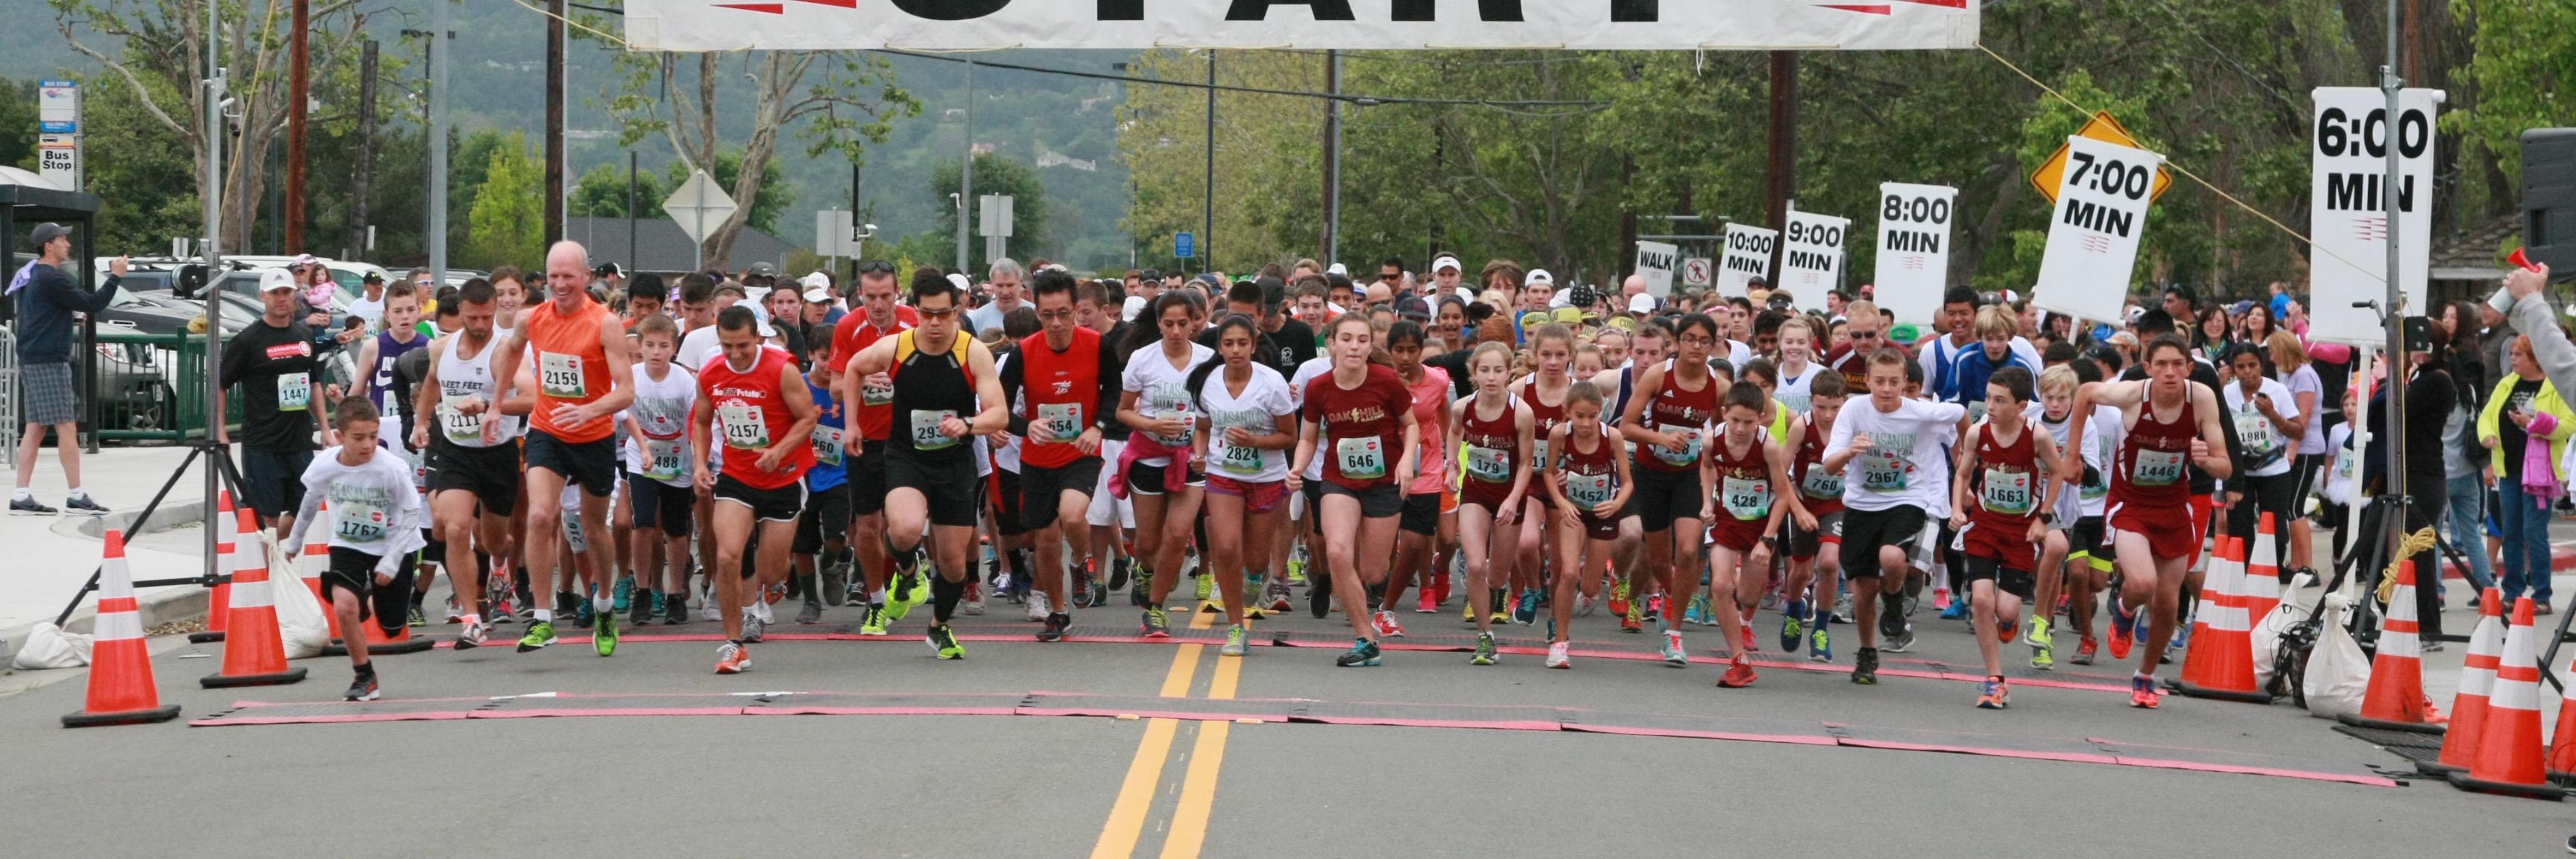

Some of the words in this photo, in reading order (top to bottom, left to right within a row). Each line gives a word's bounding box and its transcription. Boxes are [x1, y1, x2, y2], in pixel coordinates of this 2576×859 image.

[2318, 107, 2428, 159] 6:00
[45, 150, 69, 160] Bus
[42, 160, 72, 171] Stop
[2069, 150, 2149, 200] 7:00
[2327, 172, 2414, 212] MIN
[1884, 194, 1948, 224] 8:00
[2063, 197, 2133, 238] MIN
[1729, 230, 1771, 254] 10:00
[1788, 221, 1840, 247] 9:00
[1887, 229, 1939, 254] MIN
[1640, 250, 1673, 271] WALK
[1727, 255, 1764, 274] MIN
[1789, 250, 1831, 271] MIN
[462, 381, 484, 390] FEET
[545, 370, 578, 386] 2159
[282, 387, 307, 401] 1447
[449, 413, 482, 428] 2111
[1328, 411, 1352, 422] OAK
[1359, 405, 1384, 418] HILL
[727, 424, 759, 438] 2157
[2241, 431, 2267, 443] 1980
[1226, 446, 1260, 461] 2824
[1348, 454, 1374, 468] 646
[654, 456, 679, 469] 488
[1477, 459, 1500, 475] 179
[1866, 471, 1900, 484] 2967
[2139, 465, 2176, 477] 1446
[1812, 478, 1838, 491] 760
[1571, 487, 1604, 502] 1452
[1731, 494, 1758, 508] 428
[1989, 486, 2024, 503] 1663
[341, 520, 381, 537] 1767
